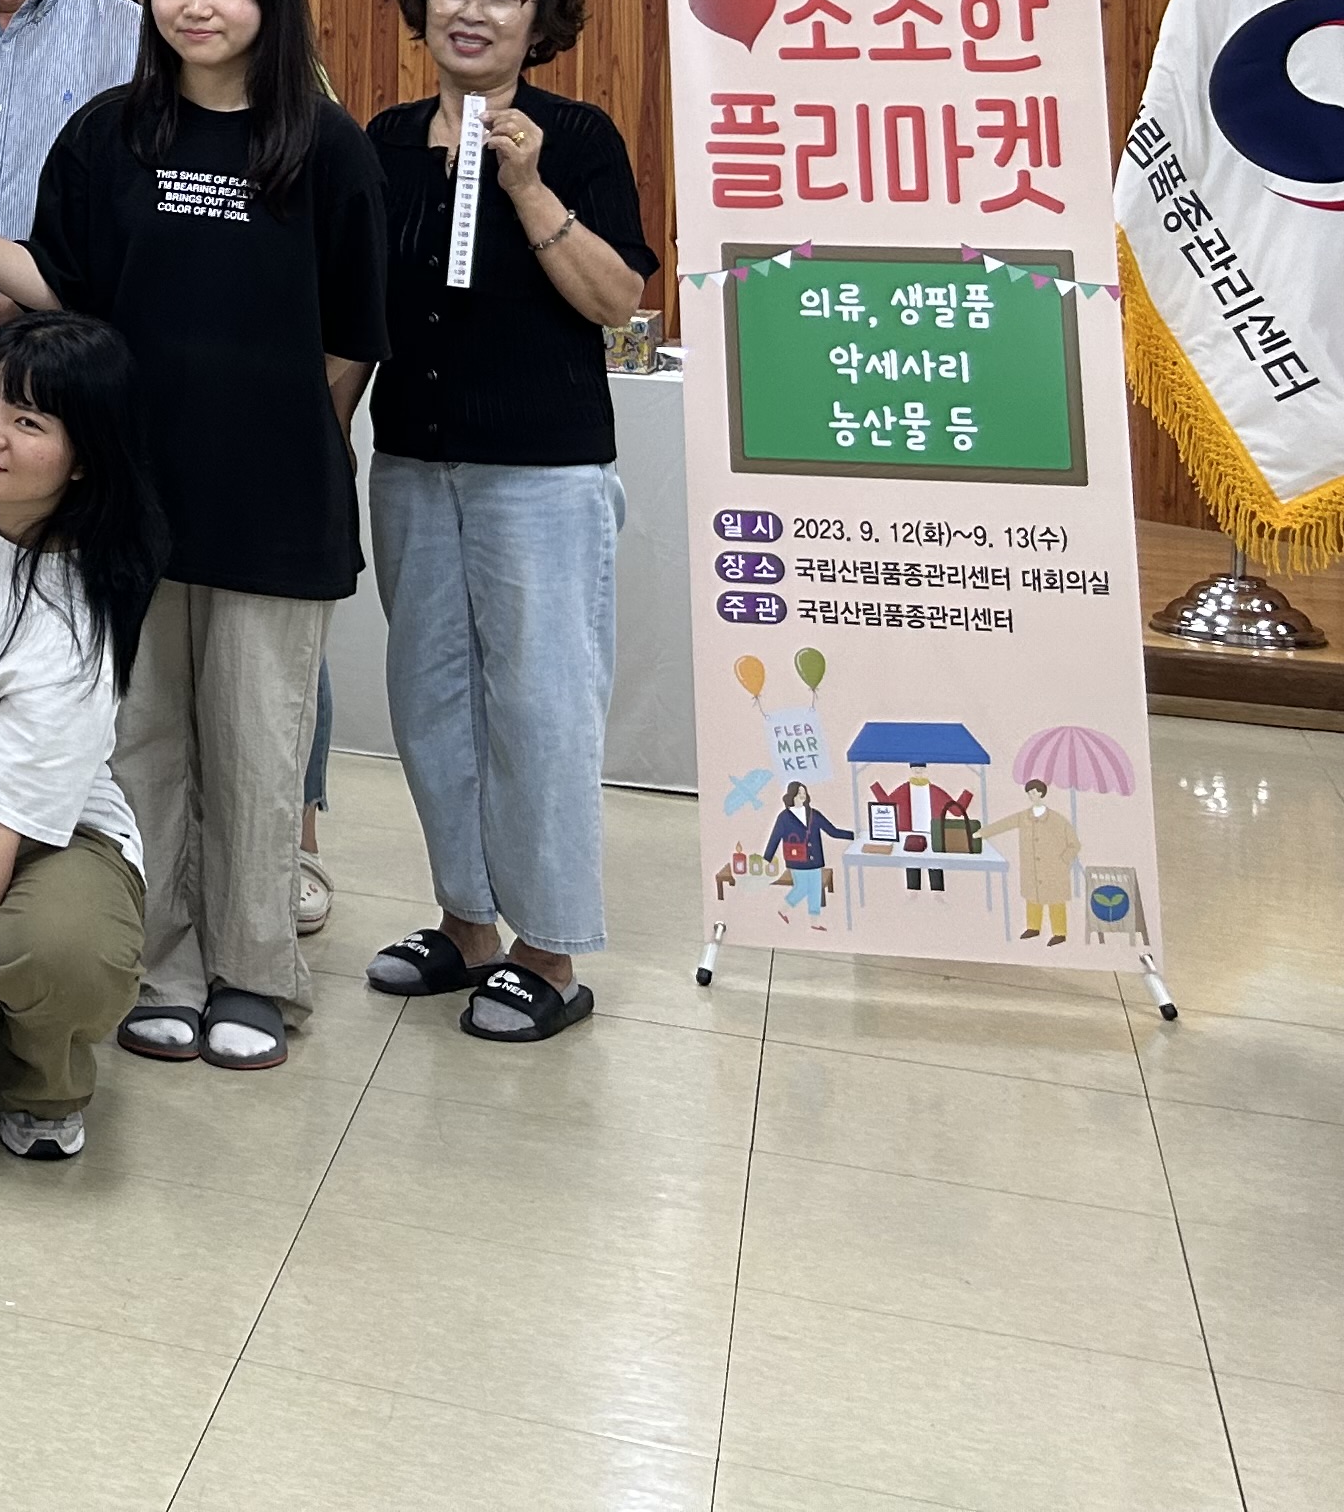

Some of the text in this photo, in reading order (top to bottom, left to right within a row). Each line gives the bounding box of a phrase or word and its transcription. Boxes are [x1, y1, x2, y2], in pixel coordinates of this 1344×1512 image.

[705, 93, 1066, 214] 플리마켓
[156, 169, 178, 179] THIS
[179, 170, 213, 183] SHADE
[213, 175, 228, 185] OF
[165, 192, 246, 209] BRINGS OUT THE
[173, 182, 217, 195] BEARING
[218, 187, 255, 199] REALLY
[157, 202, 251, 222] COLOR OF MY SOUL
[799, 283, 995, 330] 의류, 생필품
[829, 343, 971, 384] 악세사리
[828, 400, 978, 452] 농산물 등
[793, 517, 851, 542] 2023.
[859, 520, 880, 543] 9.
[890, 520, 994, 548] 12(화)~9.
[1003, 525, 1068, 553] 13(수)
[794, 557, 1011, 591] 국립산림품종관리센터
[1021, 568, 1111, 596] 대회의실
[796, 598, 1014, 633] 국립산림품종관리센터
[774, 723, 814, 738] FLEA
[777, 737, 818, 753] MAR
[782, 754, 819, 771] KET
[501, 982, 533, 1003] NEPA
